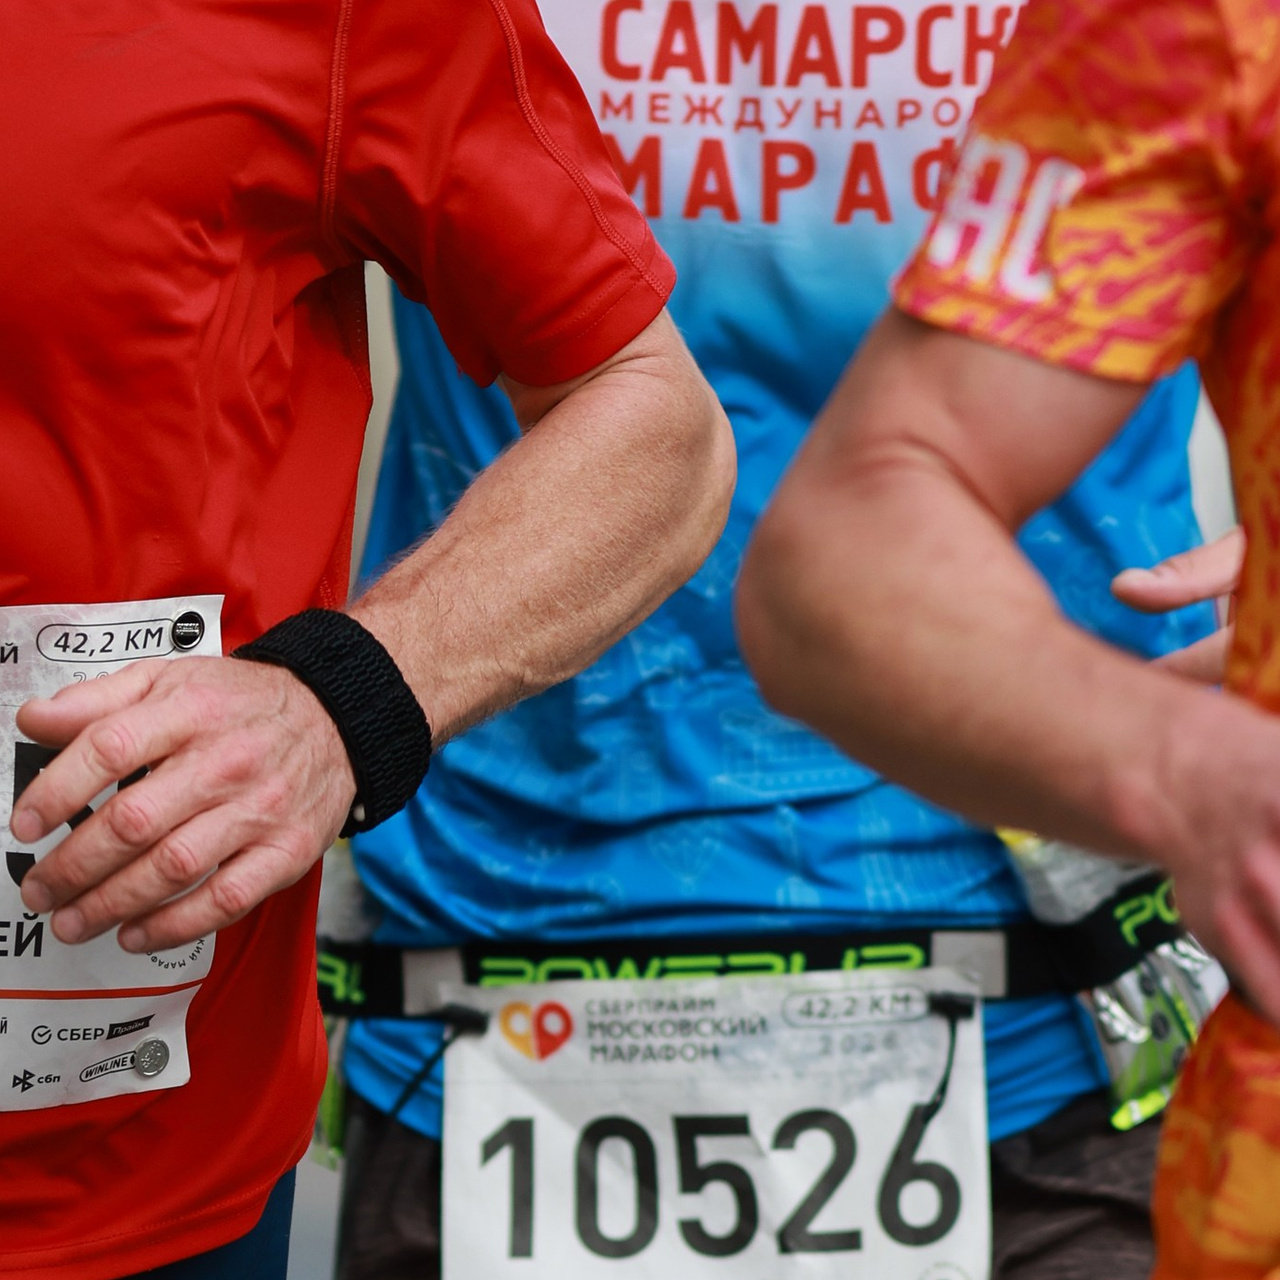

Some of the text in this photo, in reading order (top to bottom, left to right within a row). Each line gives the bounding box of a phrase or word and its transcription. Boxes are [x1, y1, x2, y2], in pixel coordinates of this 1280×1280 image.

[600, 90, 962, 133] МЕЖДУНАРО
[53, 630, 115, 658] 42,2
[584, 996, 717, 1017] СБЕРПРАЙМ
[56, 1027, 105, 1042] СБЕР
[587, 1014, 768, 1040] МОСКОВСКИЙ
[588, 1042, 720, 1063] МАРАФОН
[36, 1073, 61, 1085] сбп
[84, 1055, 129, 1079] WINLINE
[480, 1108, 962, 1260] 10526
